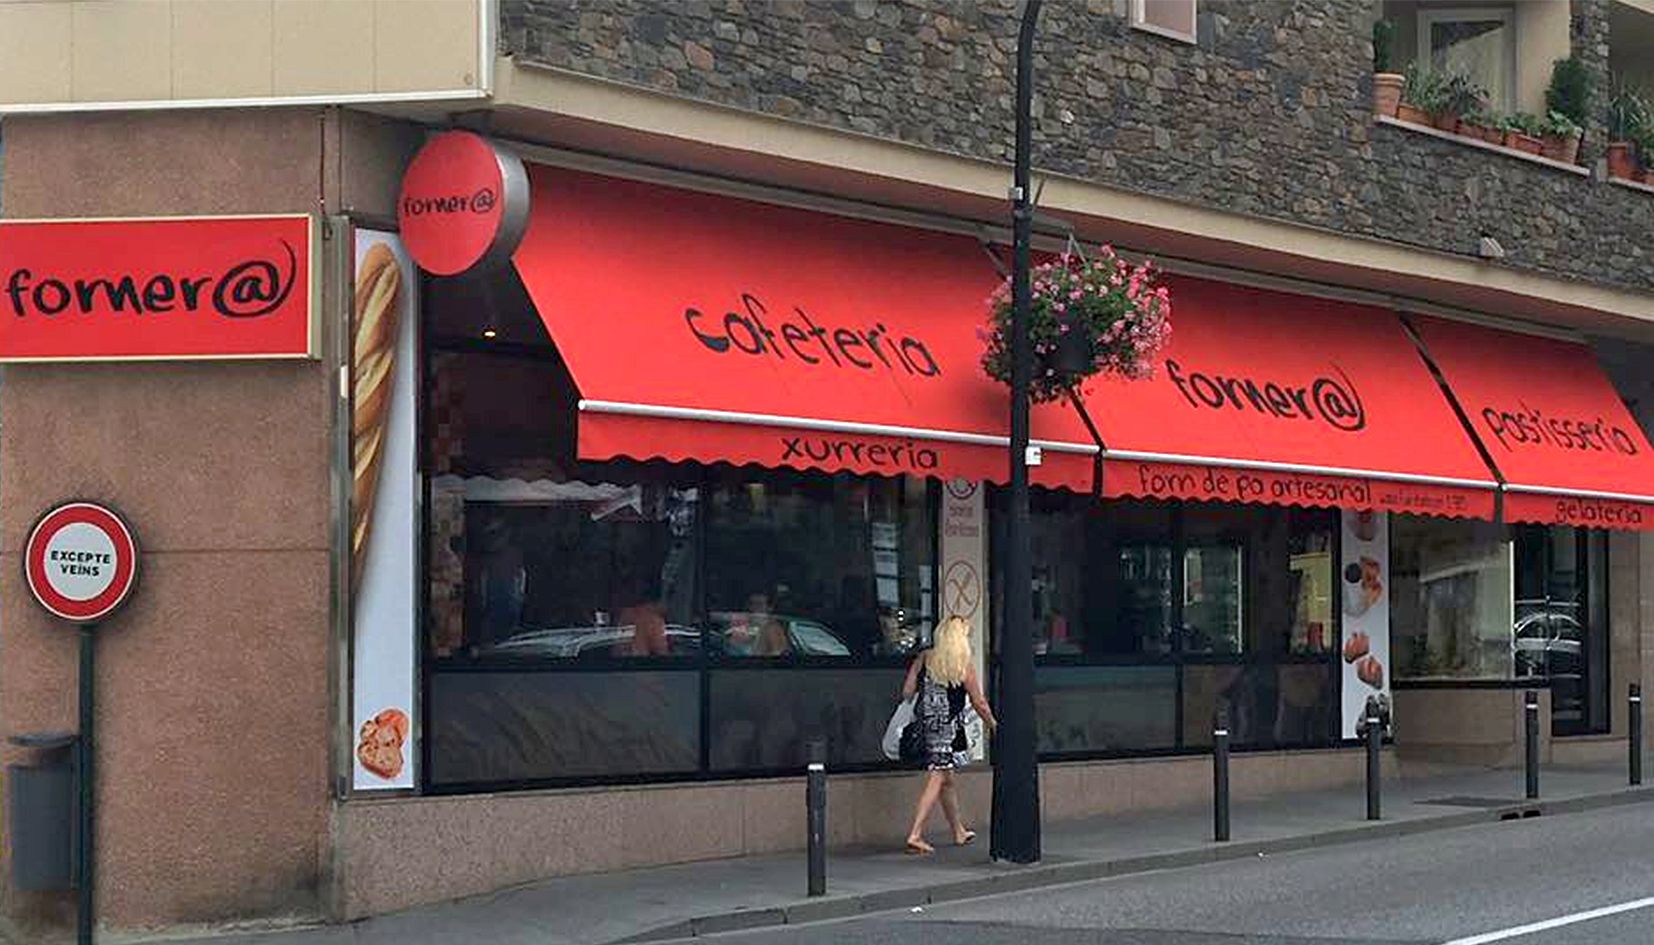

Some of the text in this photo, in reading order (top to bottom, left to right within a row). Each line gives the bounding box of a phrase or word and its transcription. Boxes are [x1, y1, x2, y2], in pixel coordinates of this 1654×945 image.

[6, 240, 296, 318] forner@
[685, 294, 941, 376] cafeteria
[1165, 359, 1366, 431] forner@
[1482, 400, 1638, 455] pastisseria
[781, 437, 938, 468] xurreria
[1139, 465, 1195, 494] forn
[1203, 467, 1229, 494] de
[1271, 478, 1371, 503] artesanal
[1555, 497, 1642, 523] gelateria
[51, 551, 110, 564] EXCEPTE
